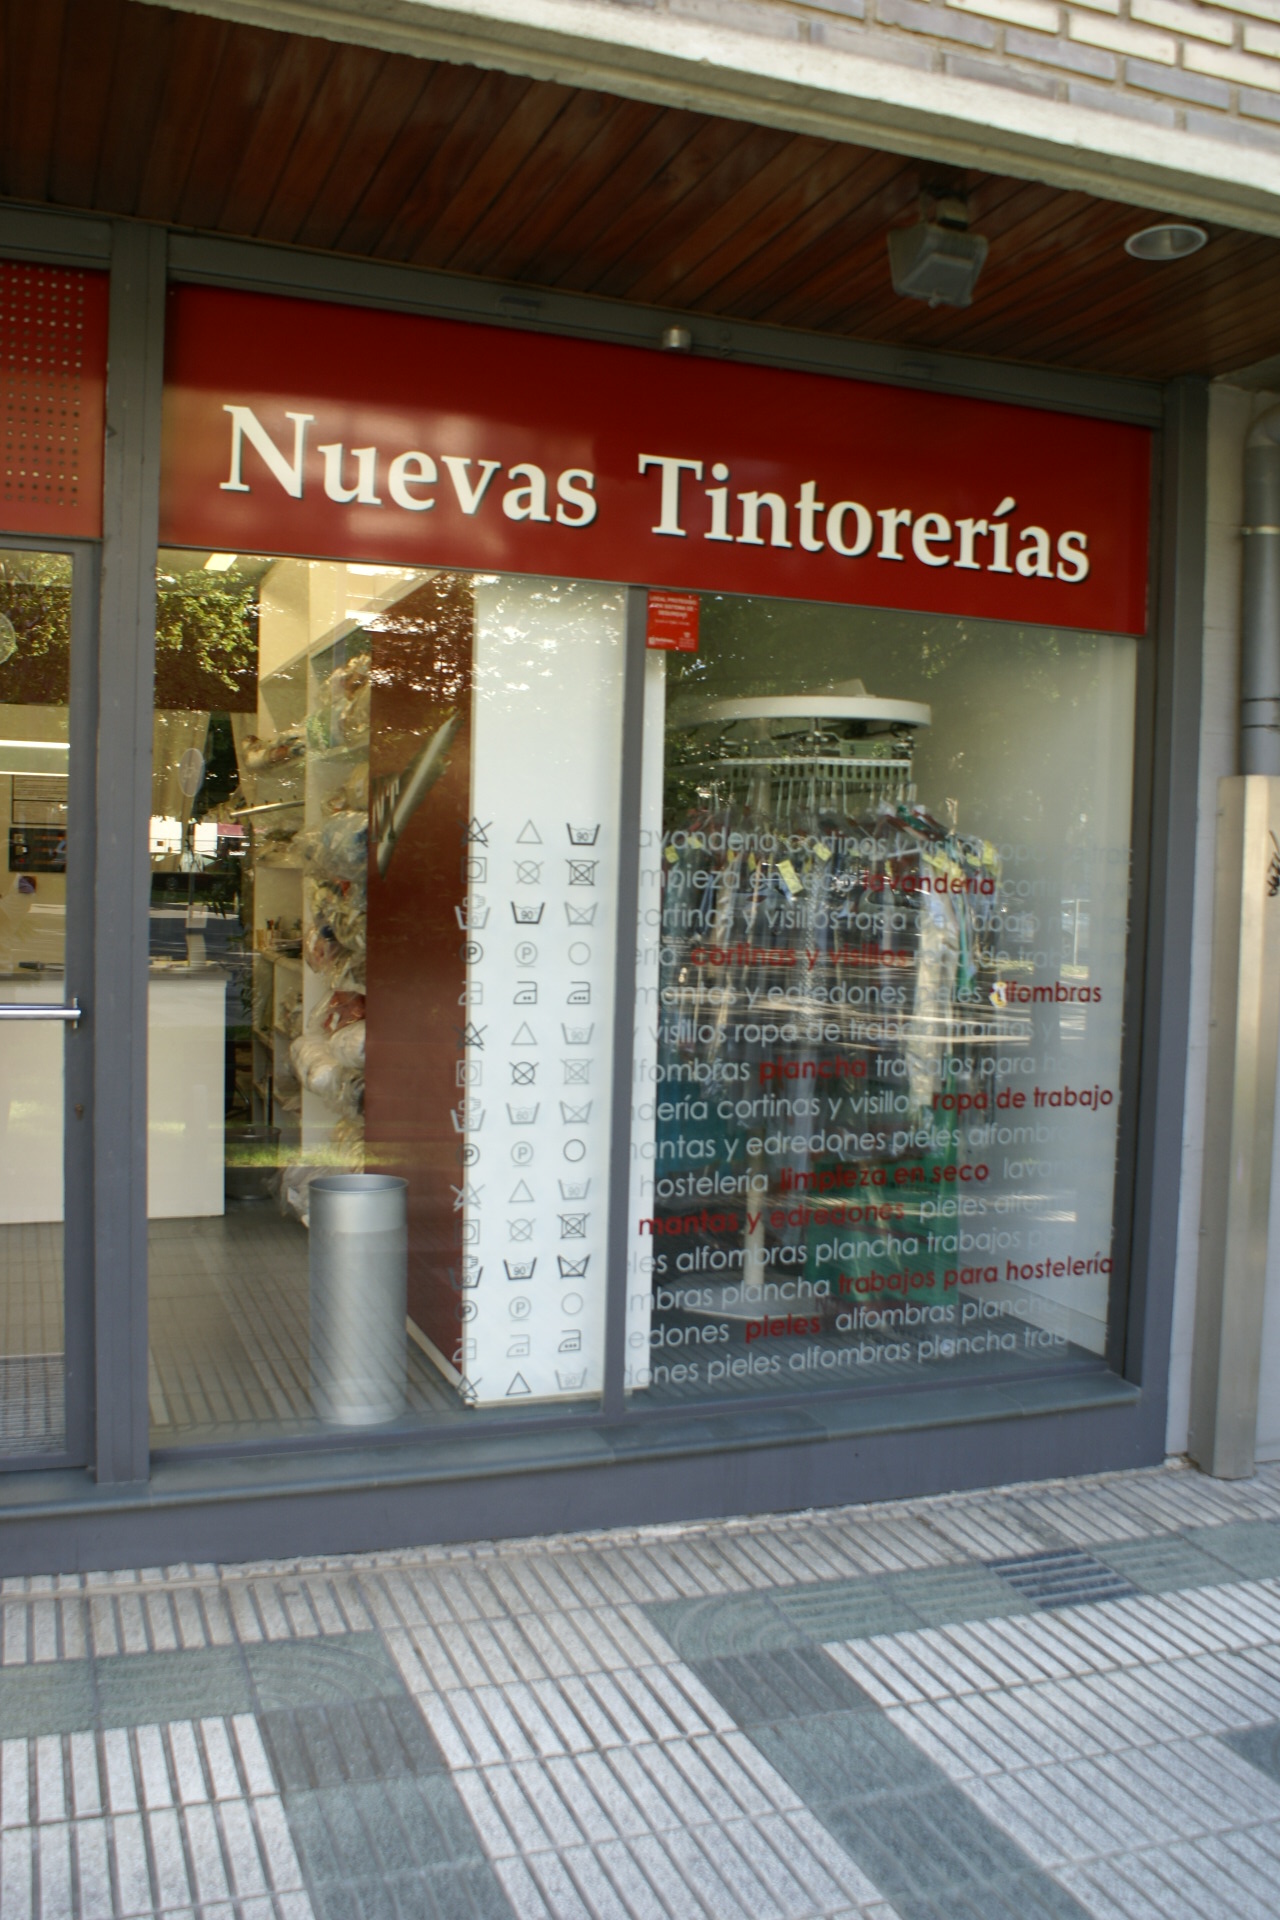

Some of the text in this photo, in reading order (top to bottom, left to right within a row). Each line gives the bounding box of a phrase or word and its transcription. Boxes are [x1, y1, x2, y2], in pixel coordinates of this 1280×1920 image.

[220, 403, 1090, 585] Nuevas Tintorerías
[786, 829, 888, 857] cortinas
[796, 873, 855, 892] eco
[863, 872, 996, 896] lavandería
[765, 903, 839, 930] visillos
[847, 909, 907, 935] ropa
[691, 943, 797, 967] cortinas
[805, 947, 820, 971] y
[829, 942, 908, 967] visillos
[636, 980, 1102, 1009] mantas y edredones peles lfombras
[734, 1022, 797, 1048] ropa
[807, 1018, 840, 1042] de
[760, 1055, 867, 1085] plancha
[875, 1053, 973, 1080] traajos
[980, 1054, 1036, 1079] para
[717, 1094, 821, 1120] cortinas
[828, 1097, 843, 1121] y
[850, 1089, 917, 1115] visillo
[932, 1090, 989, 1117] ropa
[997, 1086, 1026, 1109] de
[1034, 1084, 1115, 1112] trabajo
[724, 1138, 740, 1162] y
[746, 1129, 886, 1157] edredones
[892, 1124, 962, 1156] pieles
[639, 1167, 769, 1198] hostelería
[780, 1164, 887, 1194] limpieza
[893, 1166, 925, 1185] en
[932, 1162, 990, 1184] seco
[639, 1206, 739, 1236] mantas
[747, 1212, 762, 1235] y
[771, 1201, 905, 1228] edredones
[919, 1194, 986, 1223] pieles
[676, 1243, 808, 1274] alfombras
[815, 1233, 919, 1267] plancha
[927, 1228, 1020, 1255] trabajos
[629, 1251, 1114, 1310] mbras plancha trabajos para hostelería
[628, 1322, 730, 1349] edones
[745, 1314, 821, 1345] pieles
[835, 1302, 955, 1333] alfombras
[707, 1352, 781, 1383] pieles
[789, 1341, 910, 1371] alfombras
[917, 1330, 1017, 1361] plancha
